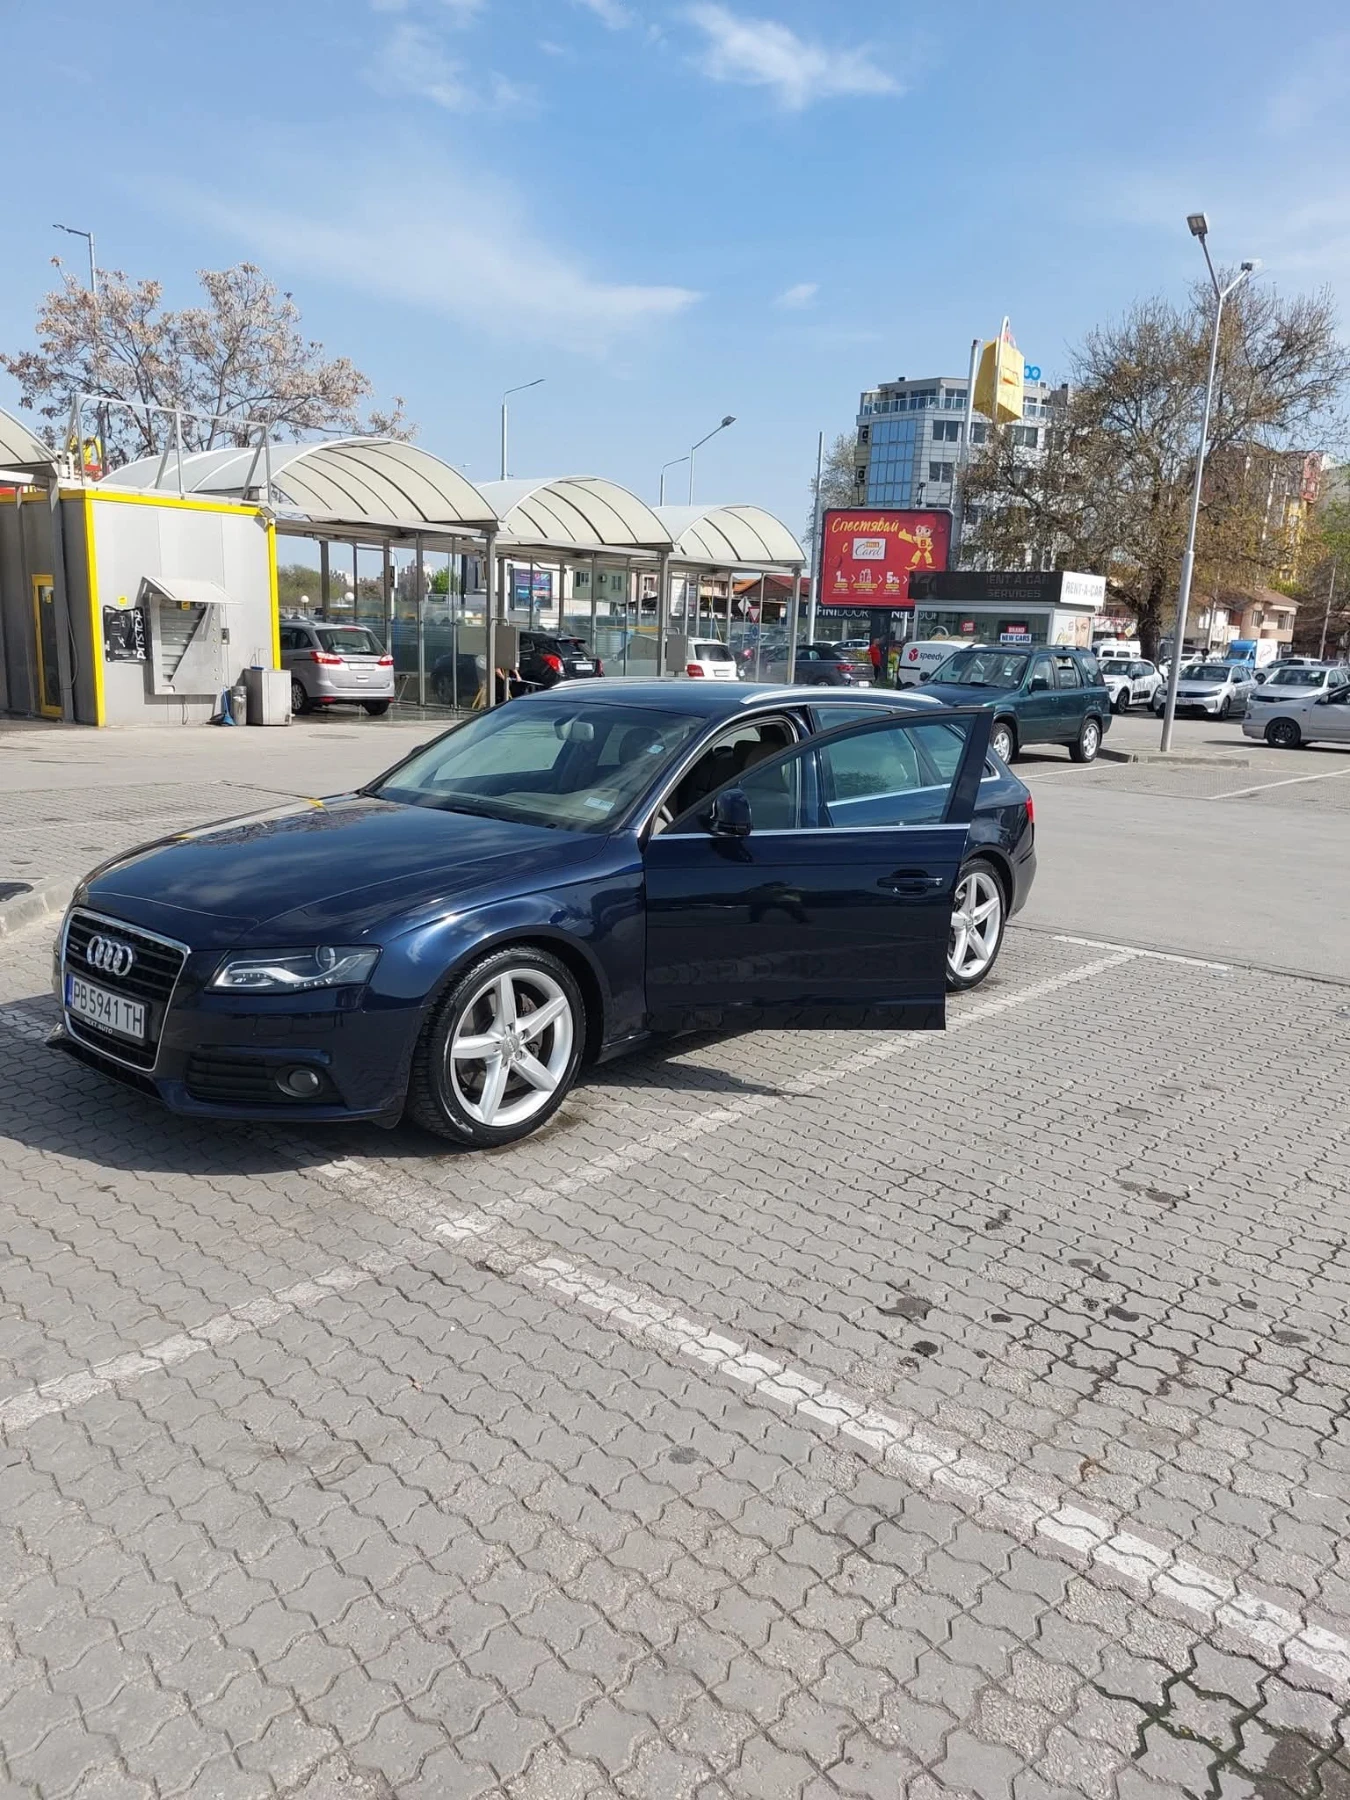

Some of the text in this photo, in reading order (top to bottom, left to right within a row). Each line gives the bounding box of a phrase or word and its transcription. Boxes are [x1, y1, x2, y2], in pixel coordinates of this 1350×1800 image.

[831, 517, 900, 533] Спестявай
[855, 542, 882, 557] Card
[986, 574, 1013, 585] ENT
[987, 589, 1042, 598] SERVICES
[1065, 581, 1104, 598] RENT-A-CAR
[805, 605, 869, 618] IFINIDOOR
[134, 609, 147, 660] PITSTOP
[1002, 634, 1014, 642] NEW
[919, 651, 944, 662] speedy
[89, 988, 119, 1025] 5941
[123, 1002, 143, 1035] TH
